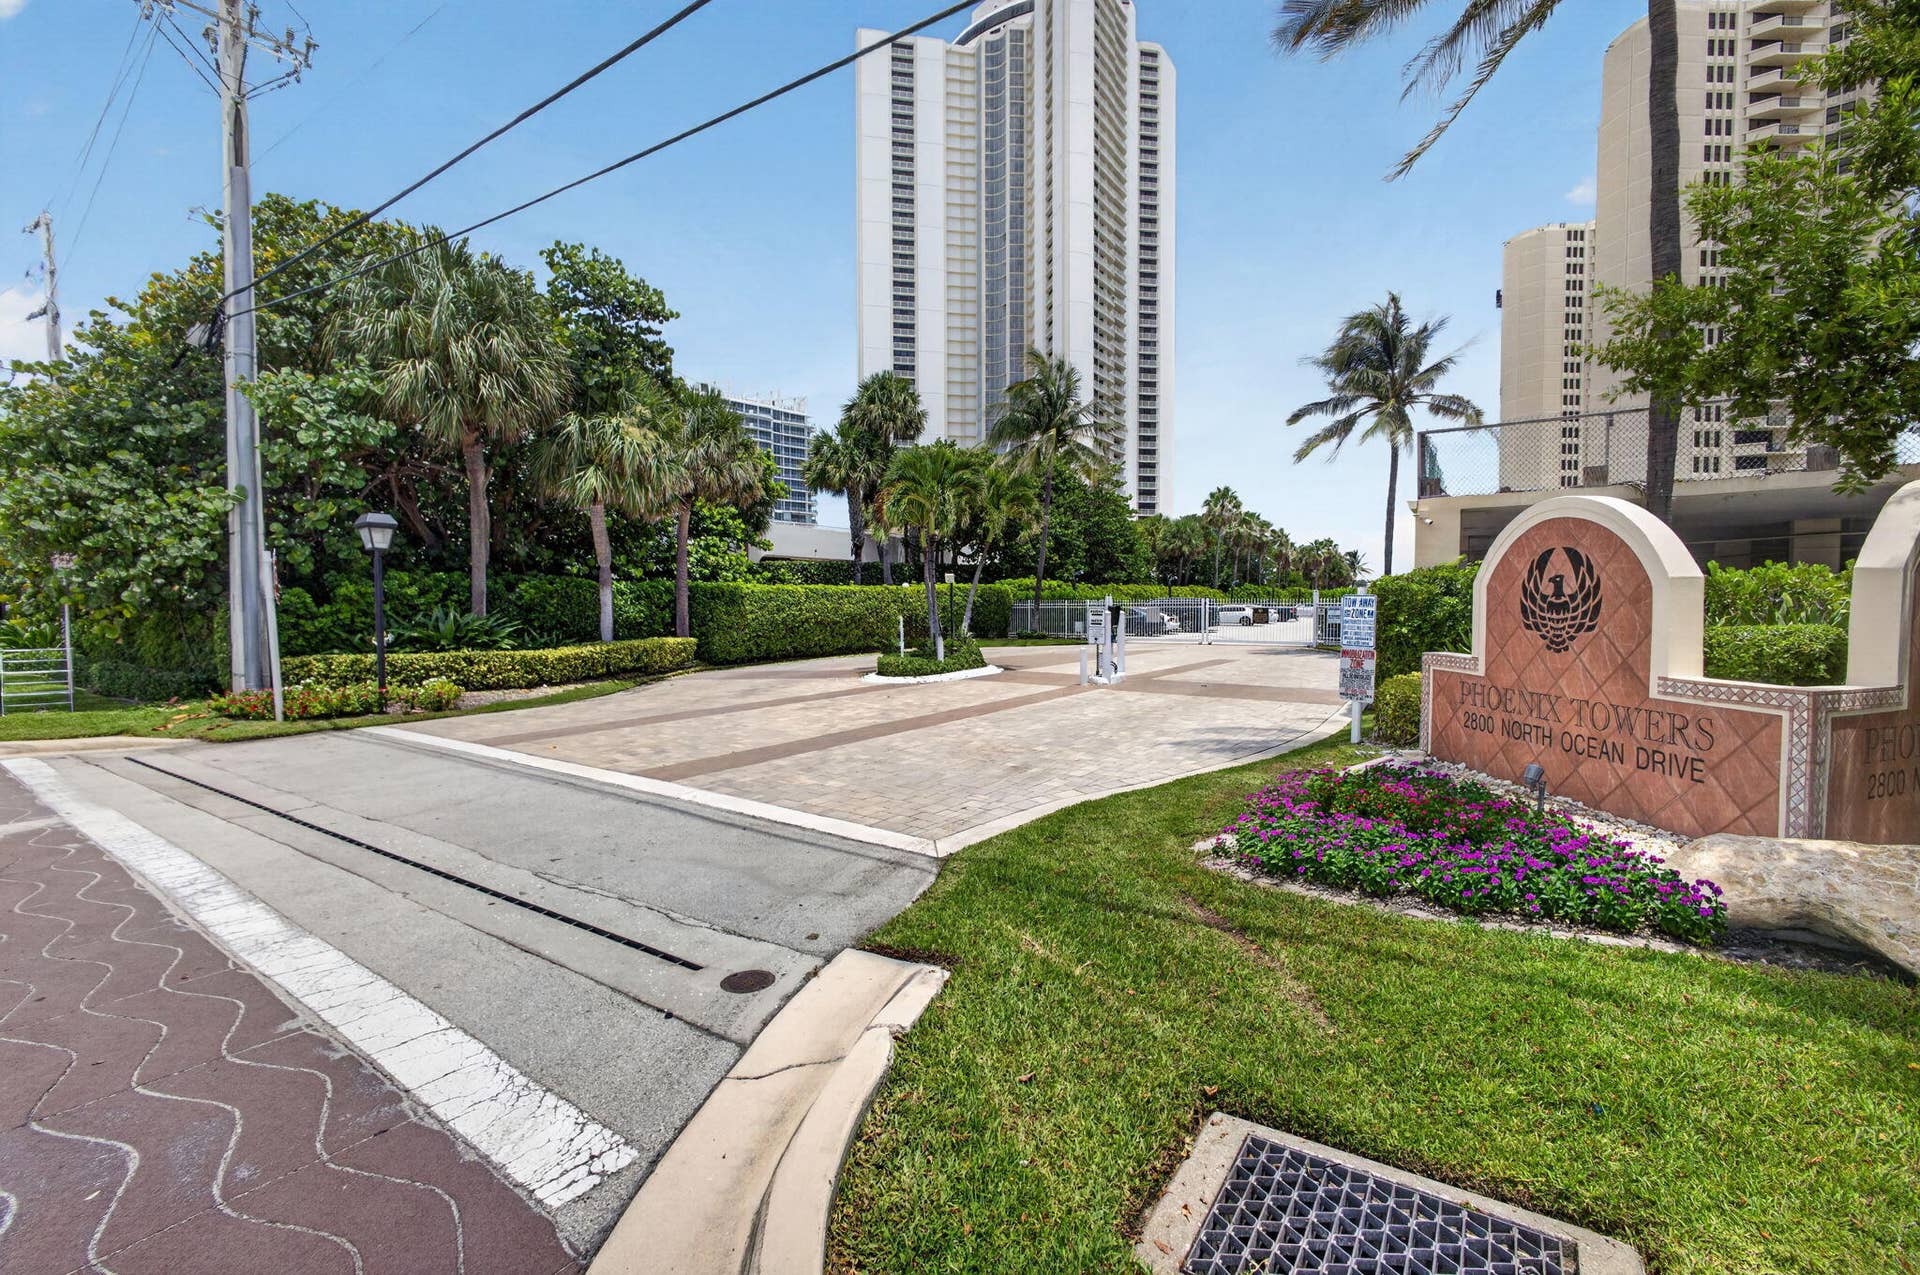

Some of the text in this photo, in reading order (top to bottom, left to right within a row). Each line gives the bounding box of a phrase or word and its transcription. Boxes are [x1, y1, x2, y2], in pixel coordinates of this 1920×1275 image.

[1345, 597, 1374, 608] TOW AWAY
[1351, 608, 1367, 619] ZONE
[1459, 680, 1715, 752] PHOENIX TOWERS
[1463, 711, 1705, 784] 2800 NORTH OCEAN DRIVE
[1867, 768, 1906, 800] 2800
